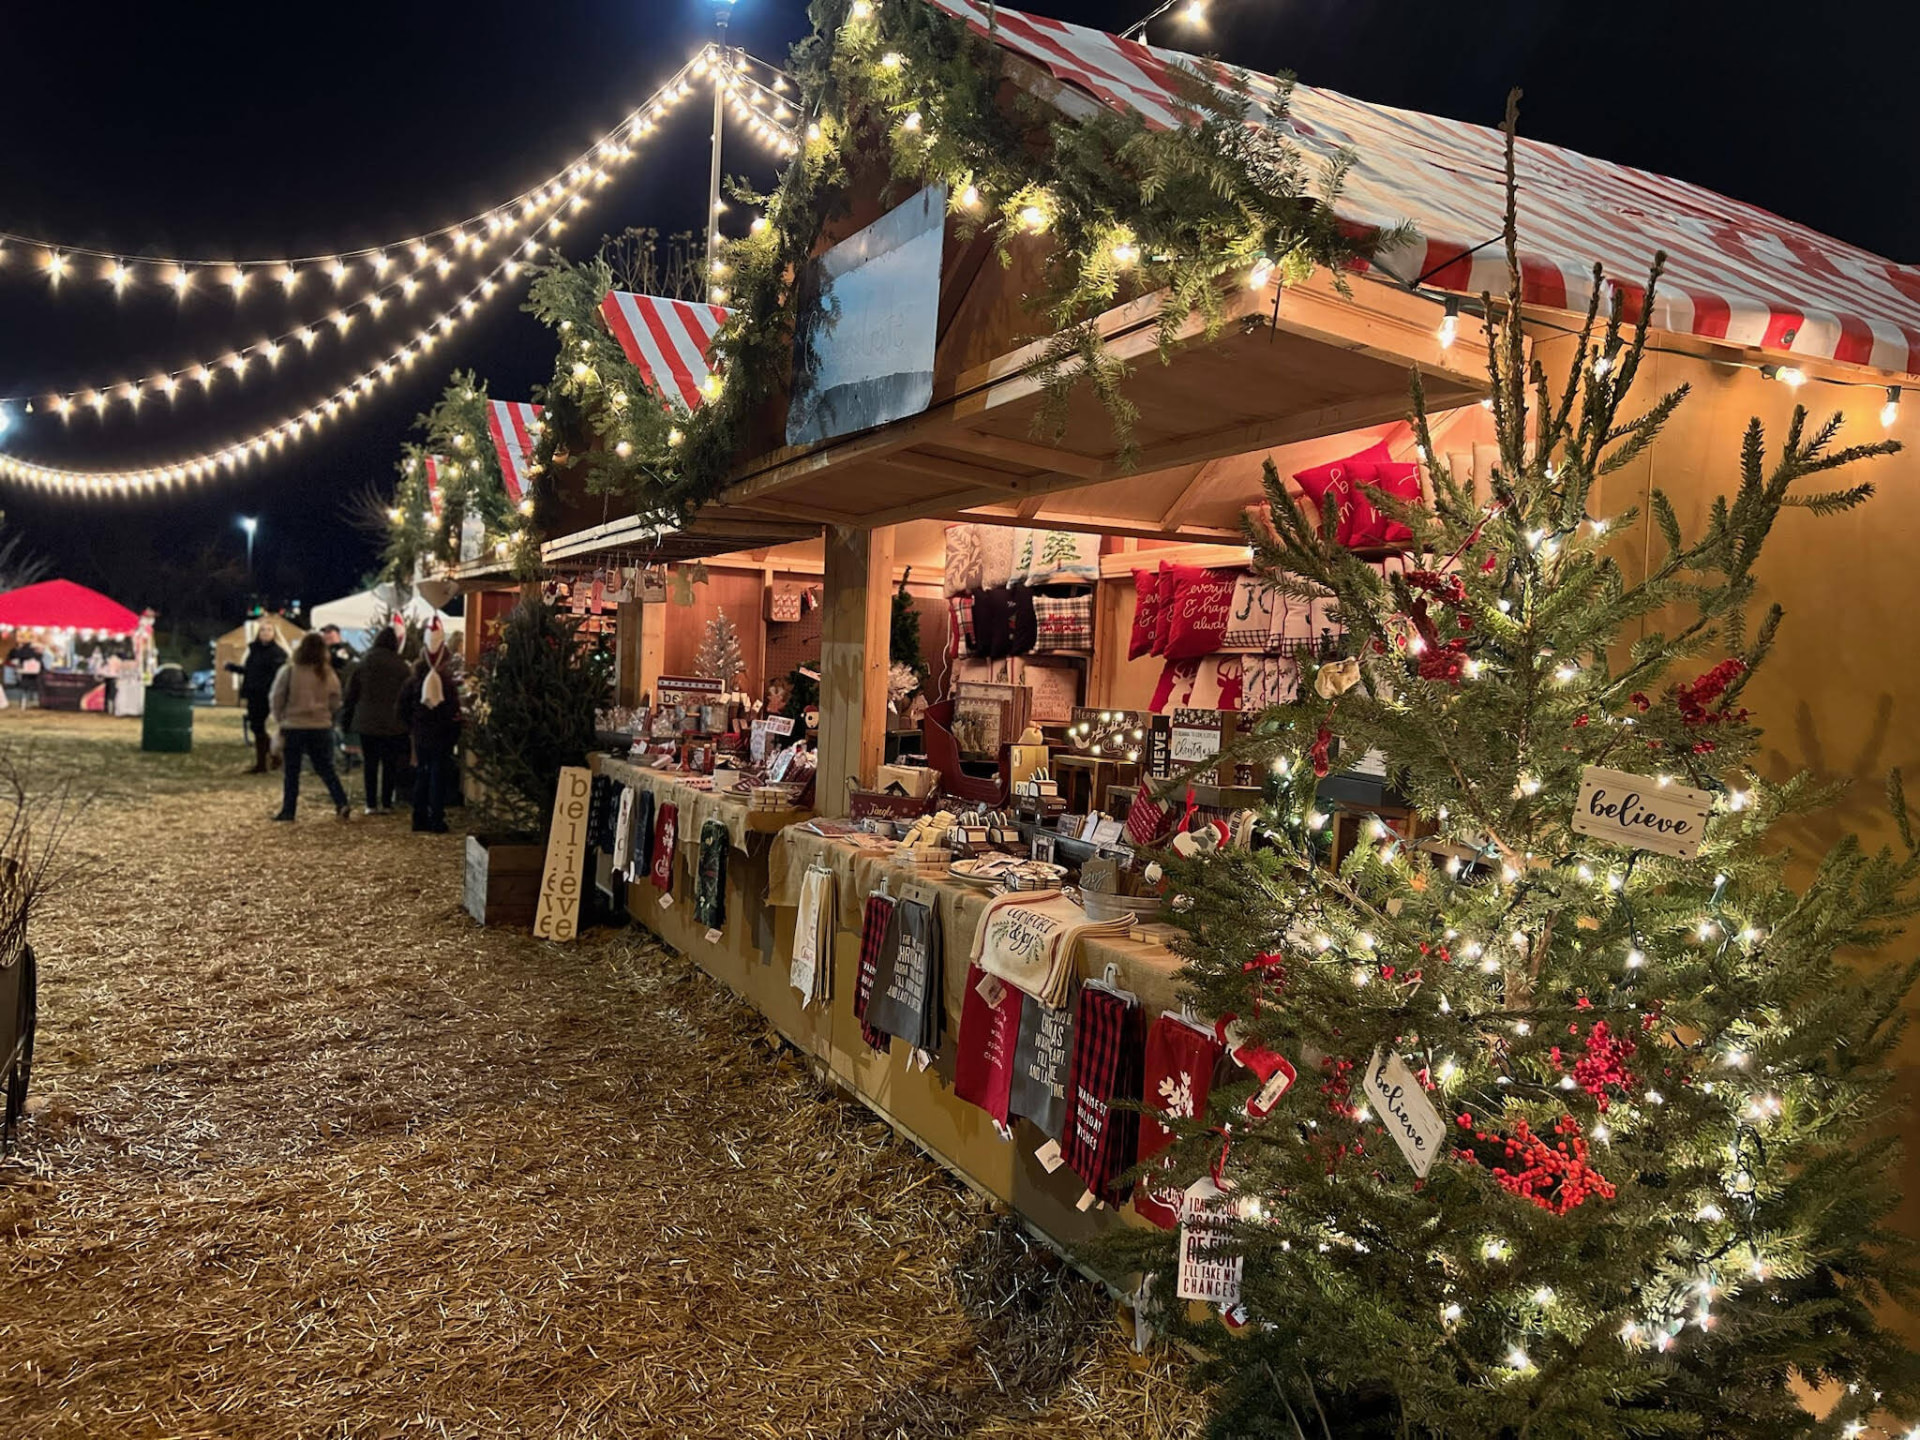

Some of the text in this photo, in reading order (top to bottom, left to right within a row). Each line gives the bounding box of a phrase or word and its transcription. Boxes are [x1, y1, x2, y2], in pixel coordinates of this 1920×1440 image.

[1198, 596, 1232, 623] hap
[1074, 708, 1101, 721] MERRY
[1102, 739, 1143, 756] CHRISTMAS
[1153, 731, 1167, 779] ELIEVE
[1590, 789, 1692, 834] believe
[555, 773, 588, 938] believe
[1007, 908, 1058, 934] COMFORT
[1078, 1085, 1107, 1117] WARMEST
[1375, 1065, 1425, 1151] believe
[1077, 1104, 1102, 1134] HOLIDAY
[1077, 1121, 1097, 1151] WISHES
[1183, 1278, 1236, 1298] CHANCES
[1184, 1264, 1236, 1282] I'LL TAKE MY
